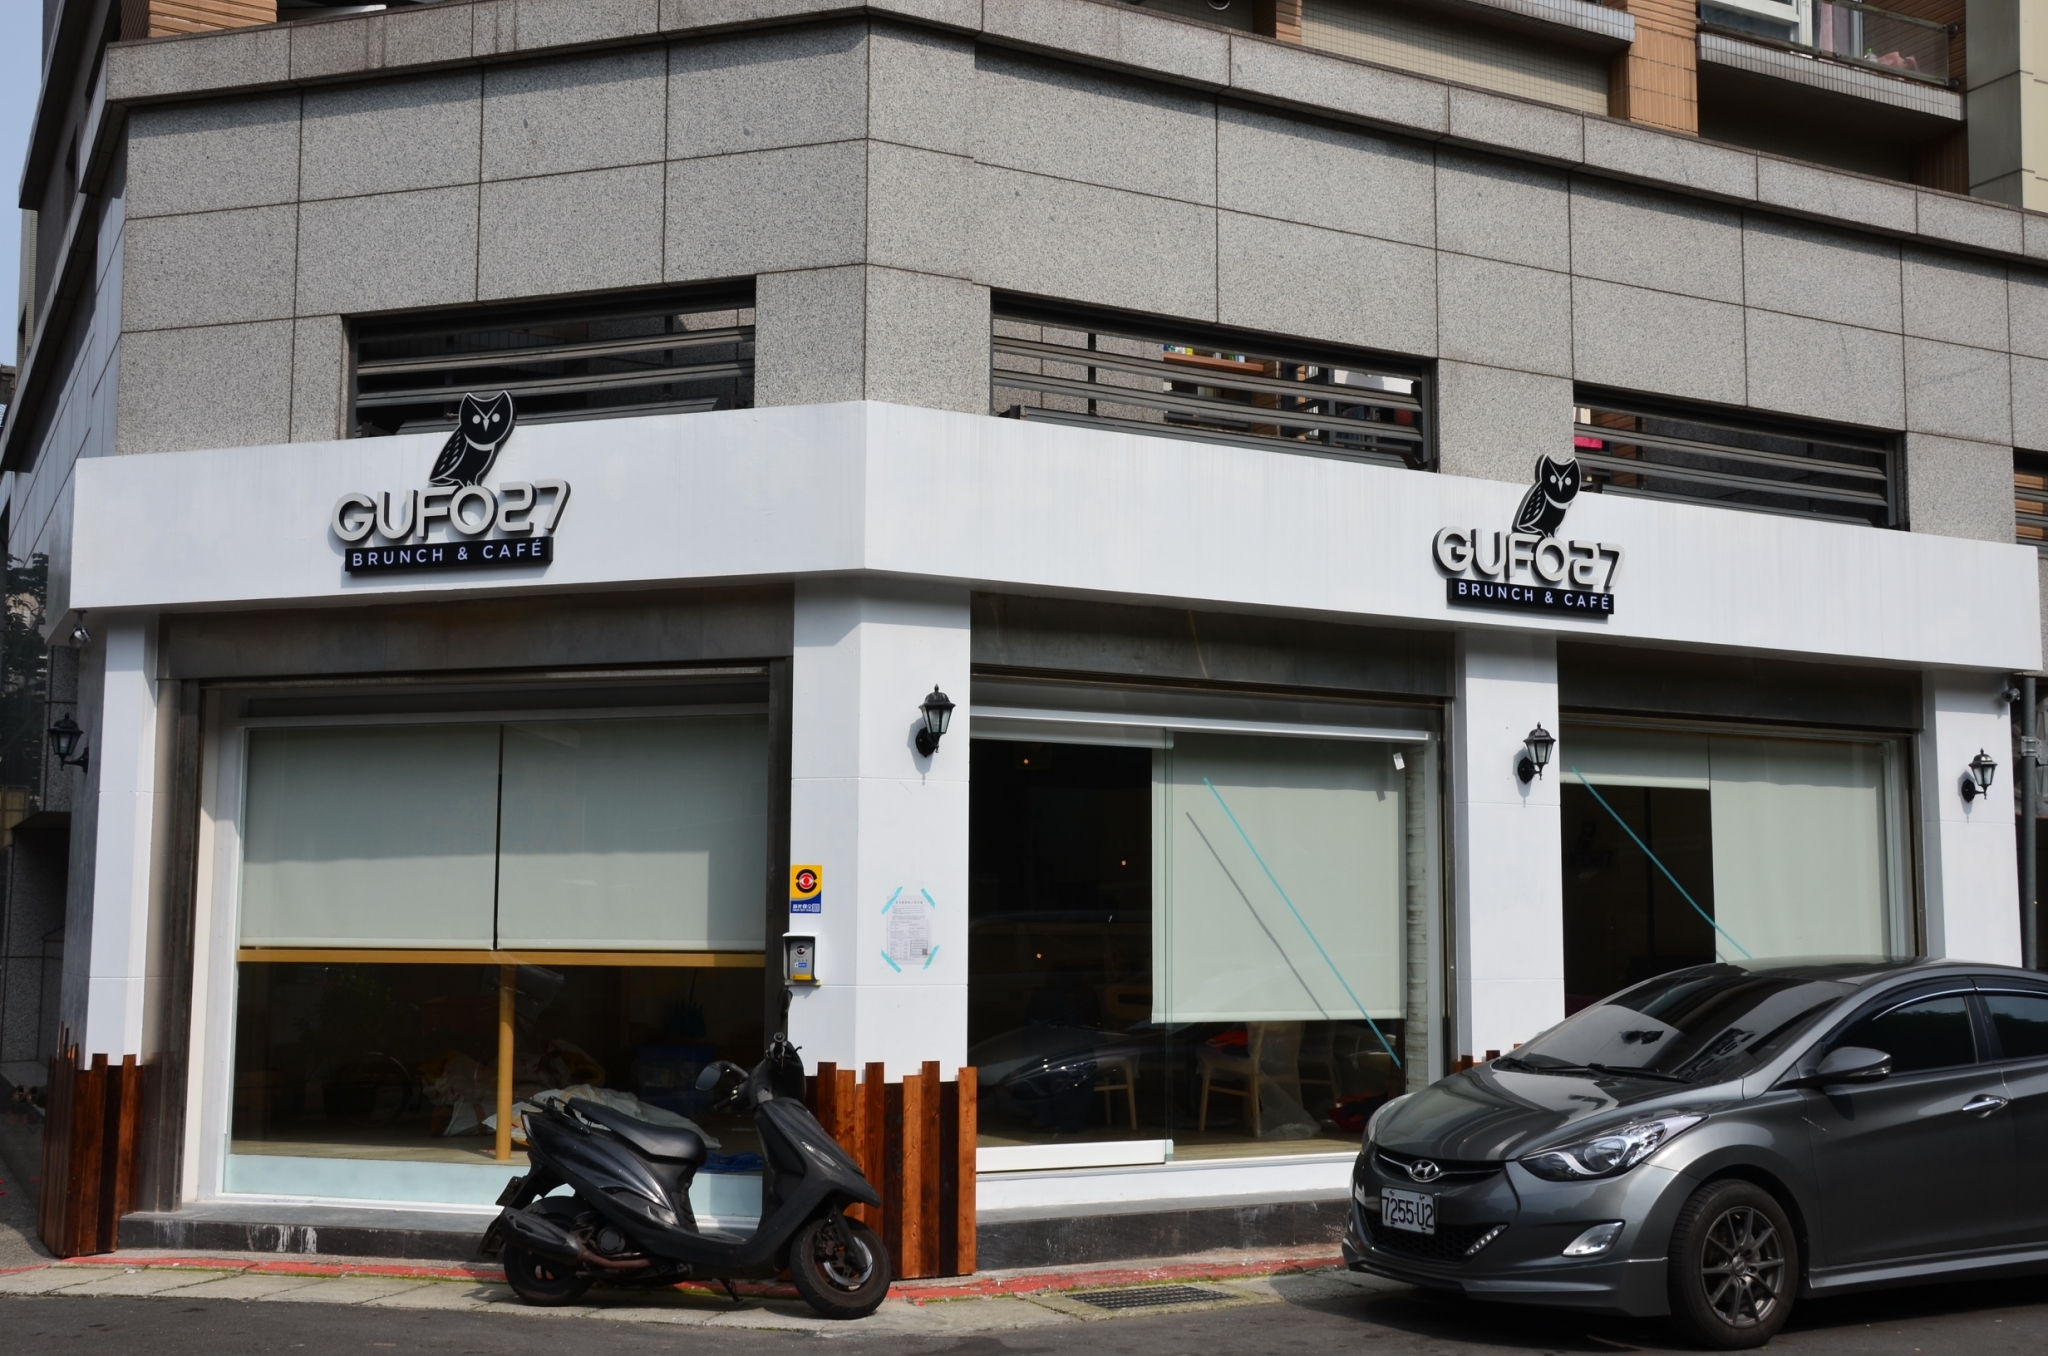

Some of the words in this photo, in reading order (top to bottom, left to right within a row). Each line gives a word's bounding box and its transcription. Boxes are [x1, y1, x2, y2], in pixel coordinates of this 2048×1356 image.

[331, 478, 571, 542] GUFO27
[352, 547, 444, 567] BRUNCH
[457, 546, 468, 561] &
[482, 538, 542, 560] CAFÉ
[1432, 526, 1625, 589] GUFO27
[1458, 581, 1534, 602] BRUNCH
[1544, 591, 1554, 604] &
[1564, 594, 1610, 610] CAFÉ
